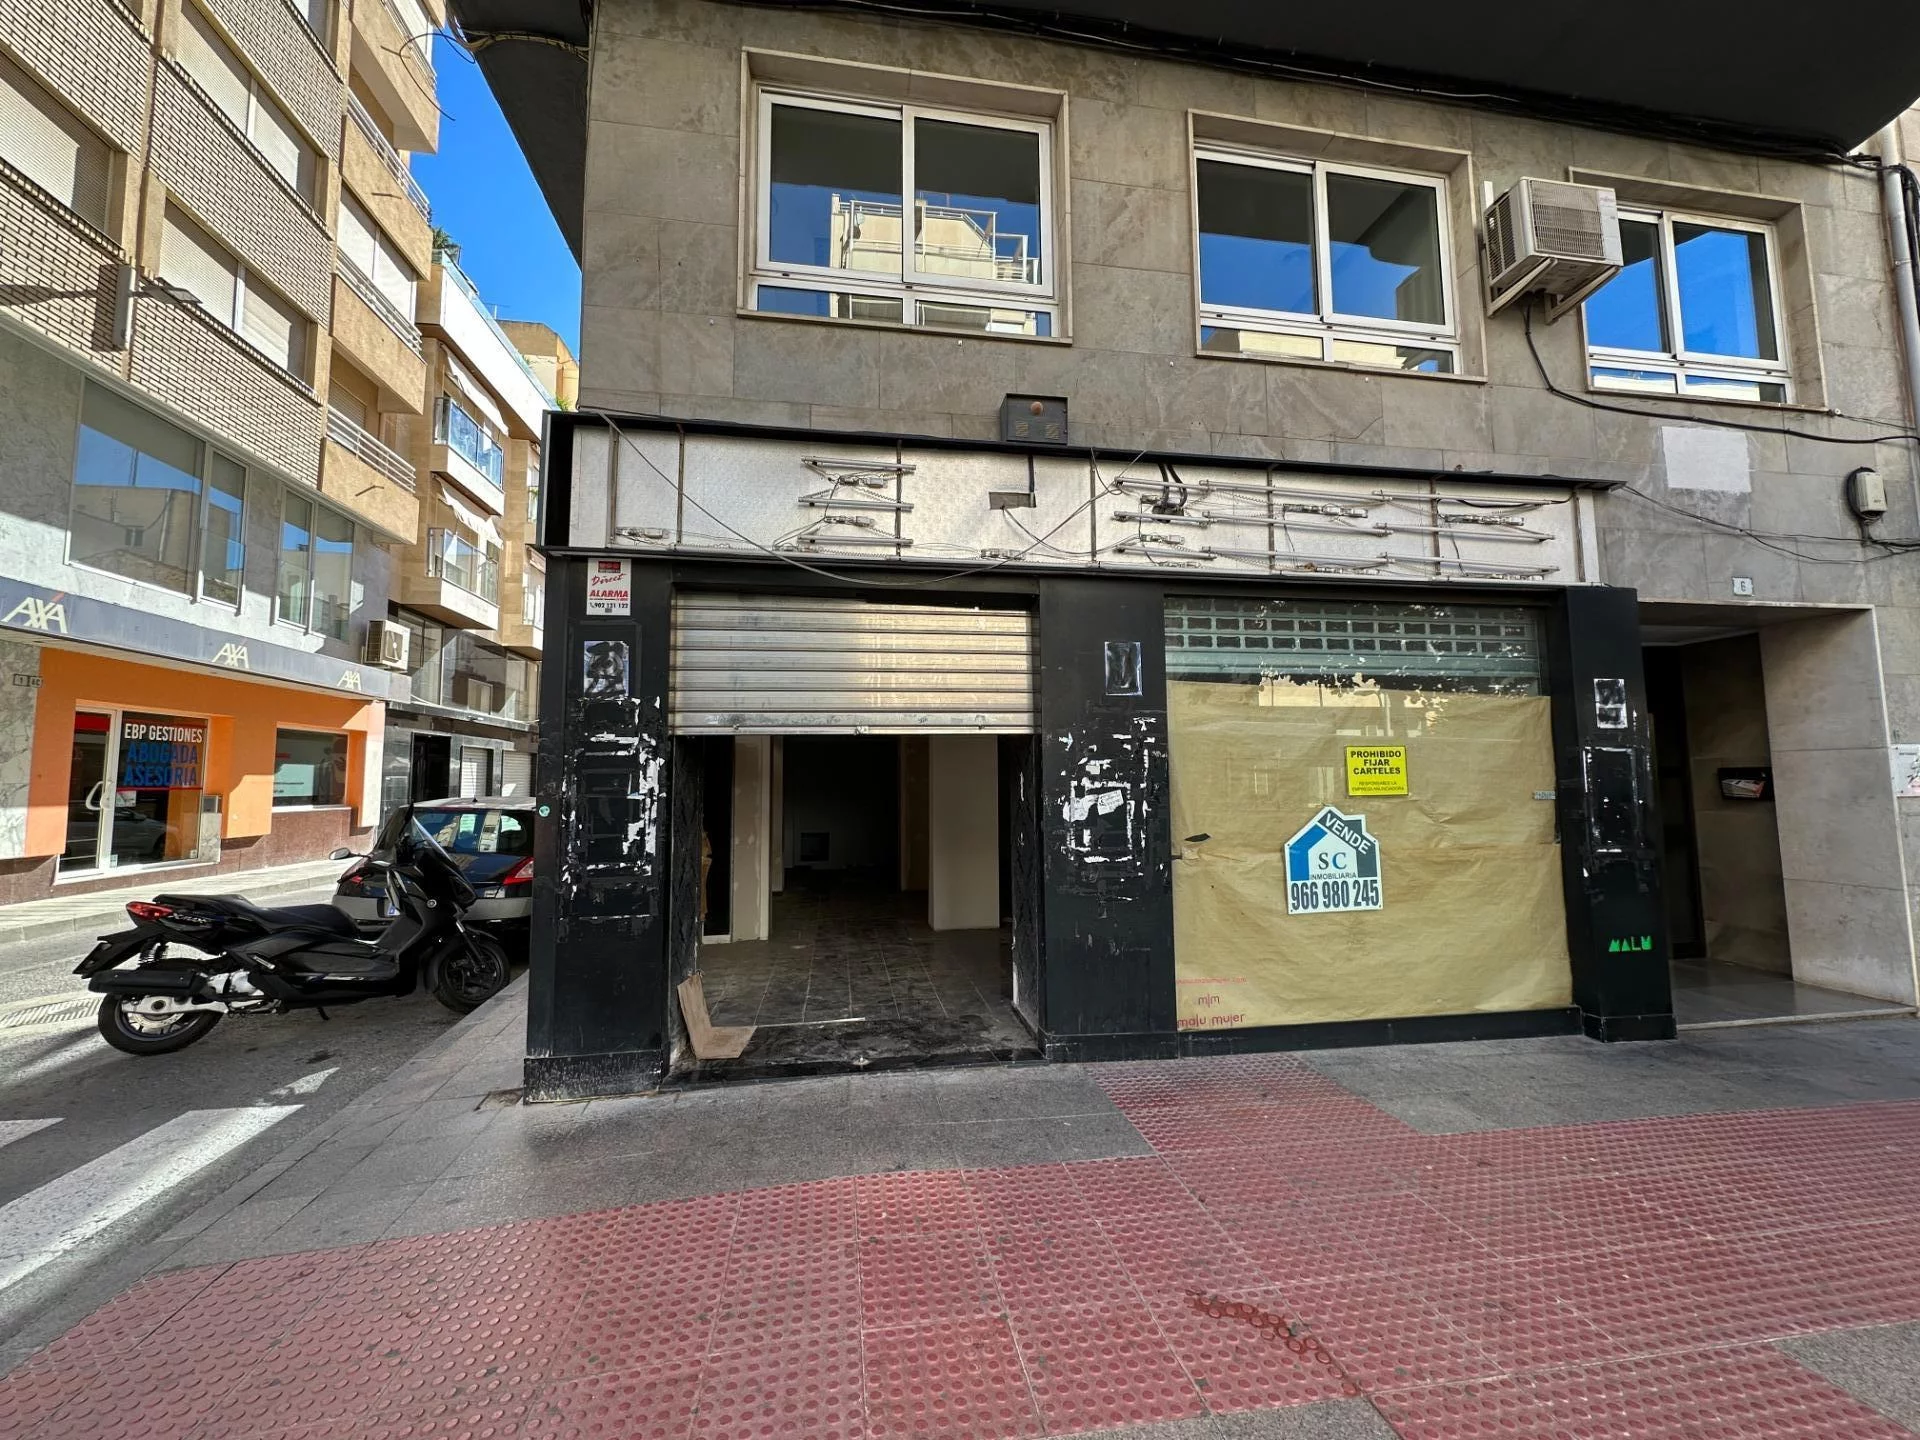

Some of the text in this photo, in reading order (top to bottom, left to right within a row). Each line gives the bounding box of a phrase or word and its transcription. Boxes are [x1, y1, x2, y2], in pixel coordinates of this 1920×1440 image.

[591, 573, 627, 586] Direct
[1740, 580, 1746, 592] 6
[590, 590, 629, 598] ALARMA
[1, 595, 68, 634] AXA
[212, 642, 249, 669] AXA
[337, 669, 362, 691] AXA
[124, 723, 203, 743] EBP GESTIONES
[127, 741, 198, 765] ABOGADA
[1350, 750, 1402, 758] PROHIBIDO
[1363, 759, 1390, 767] FIJAR
[1353, 767, 1401, 775] CARTELES
[1325, 813, 1371, 855] VENDE
[1310, 872, 1357, 880] INMOBILIARIA
[1291, 879, 1380, 910] 966 980 245
[1608, 935, 1652, 952] MALU
[1177, 1014, 1245, 1028] malu mujer
